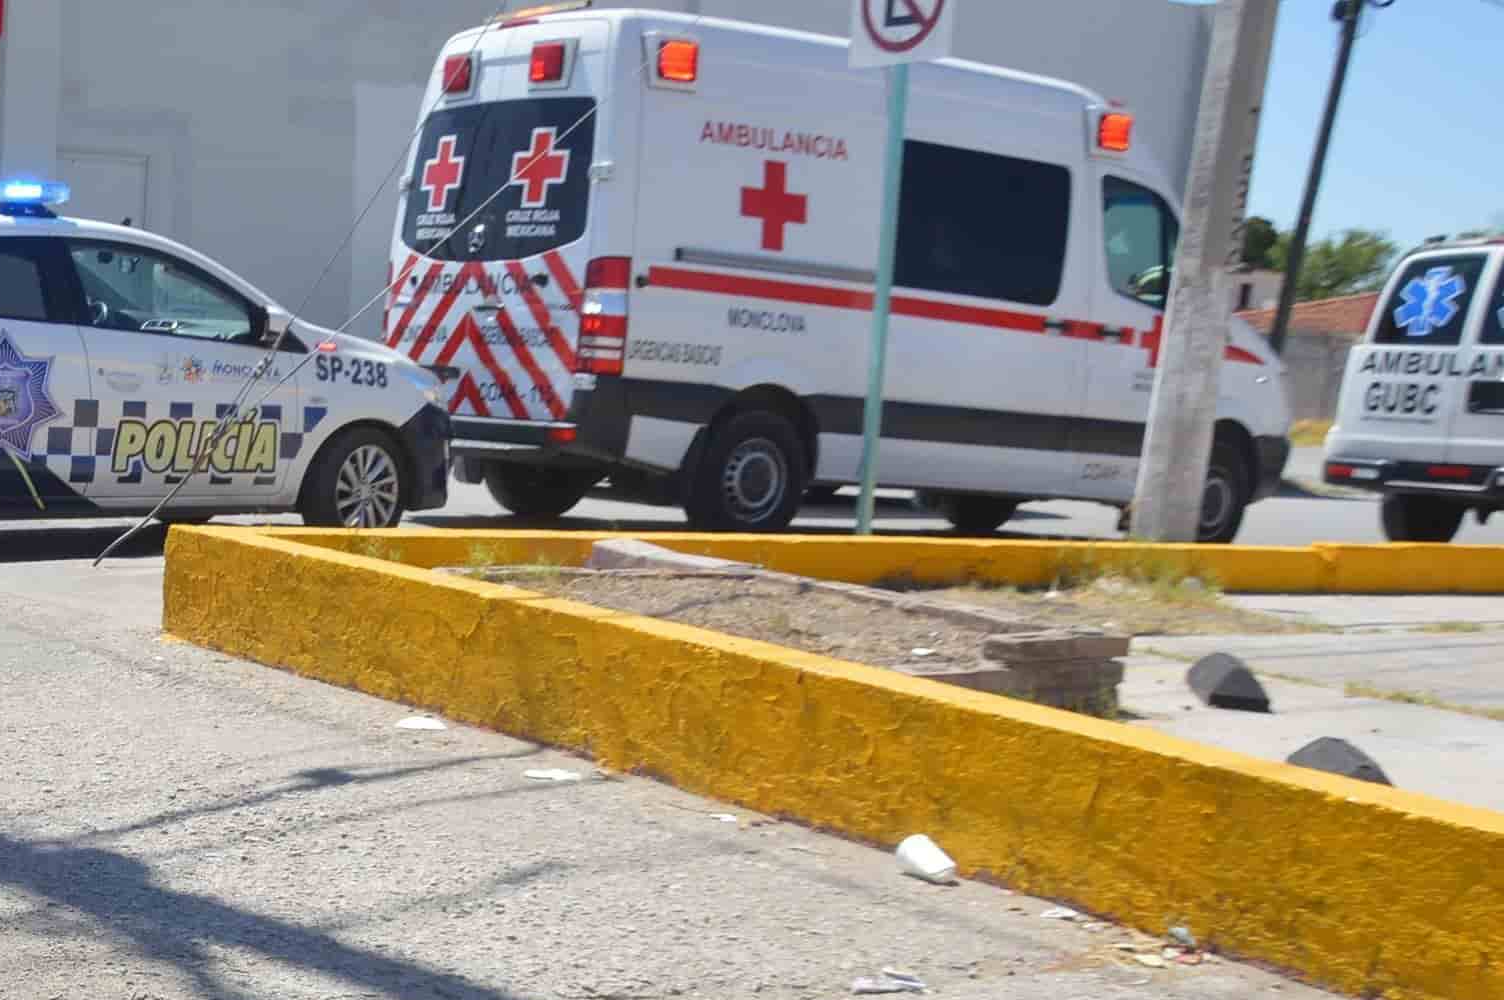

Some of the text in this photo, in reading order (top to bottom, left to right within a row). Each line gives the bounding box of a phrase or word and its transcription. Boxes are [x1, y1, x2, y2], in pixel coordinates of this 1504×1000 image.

[698, 120, 848, 160] AMBULANCIA
[505, 209, 560, 223] CRUZ ROJA
[505, 225, 556, 238] MEXICANA
[727, 307, 806, 333] MONCLOVA
[315, 353, 388, 388] SP-238
[111, 407, 278, 475] POLICÍA
